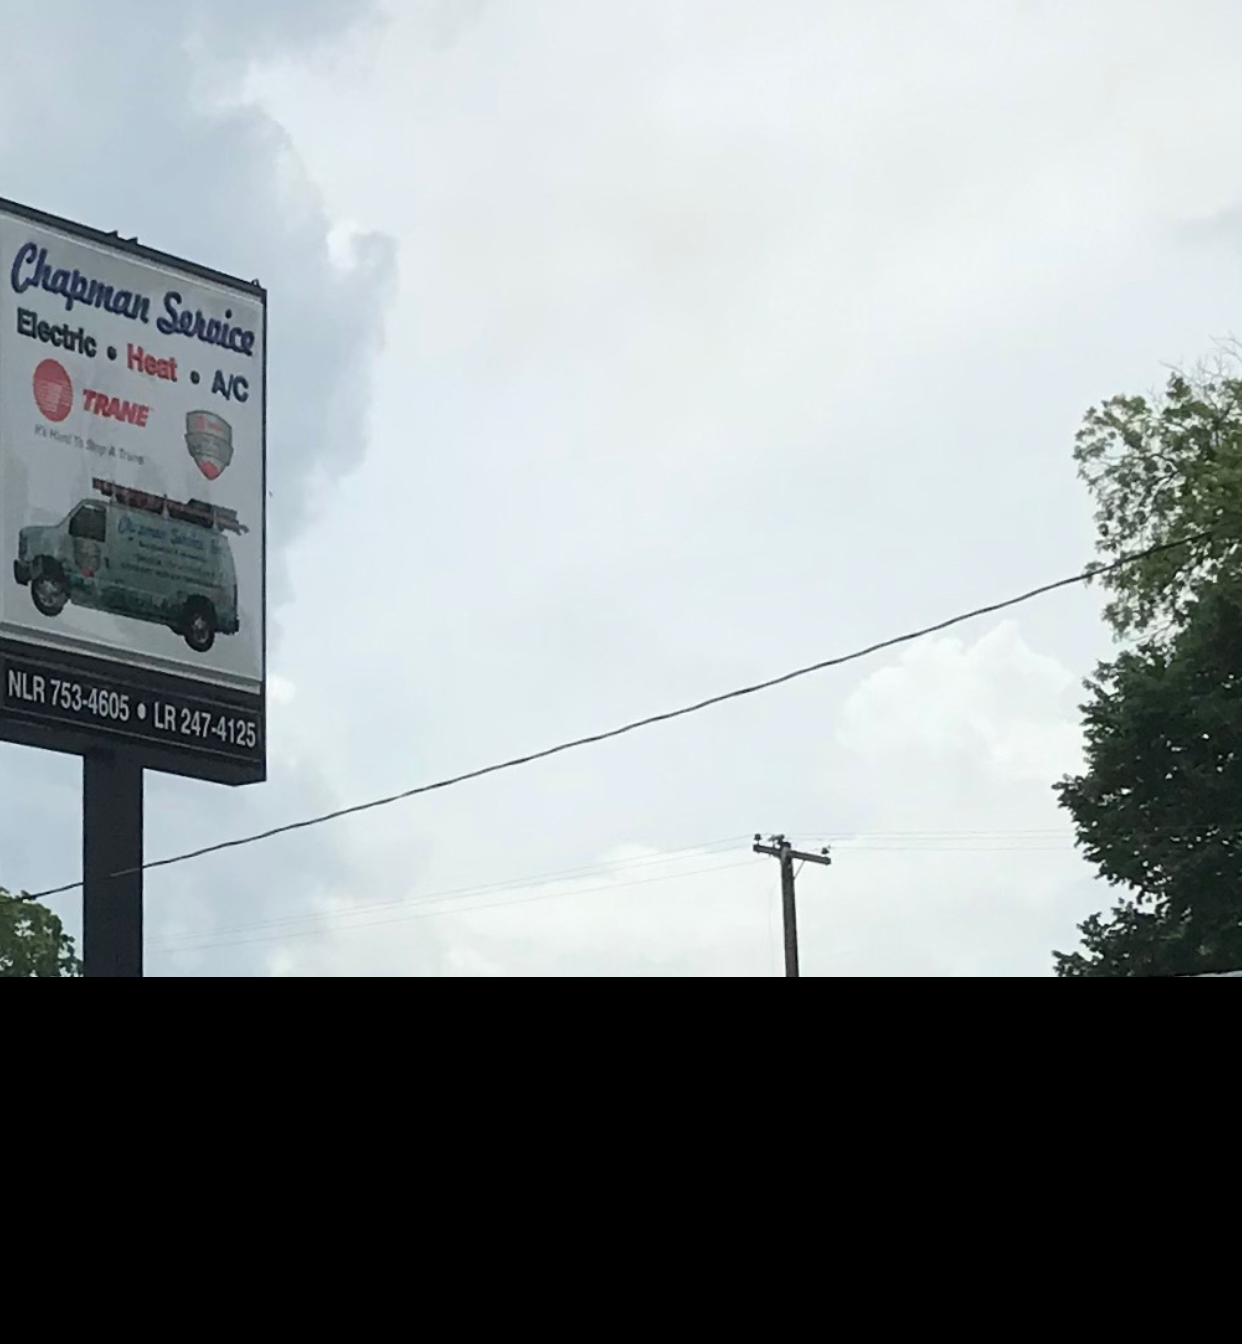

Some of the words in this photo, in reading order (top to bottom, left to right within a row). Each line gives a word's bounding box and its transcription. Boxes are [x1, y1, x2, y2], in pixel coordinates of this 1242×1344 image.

[11, 241, 151, 324] Chapman
[156, 291, 256, 356] Service
[17, 307, 97, 358] Electric
[127, 343, 178, 382] Heat
[211, 369, 250, 403] A/C
[82, 388, 150, 427] TRANE
[8, 669, 46, 703] NLR
[49, 679, 130, 722] 753-4605
[153, 701, 177, 732] LR
[179, 707, 257, 749] 247-4125
